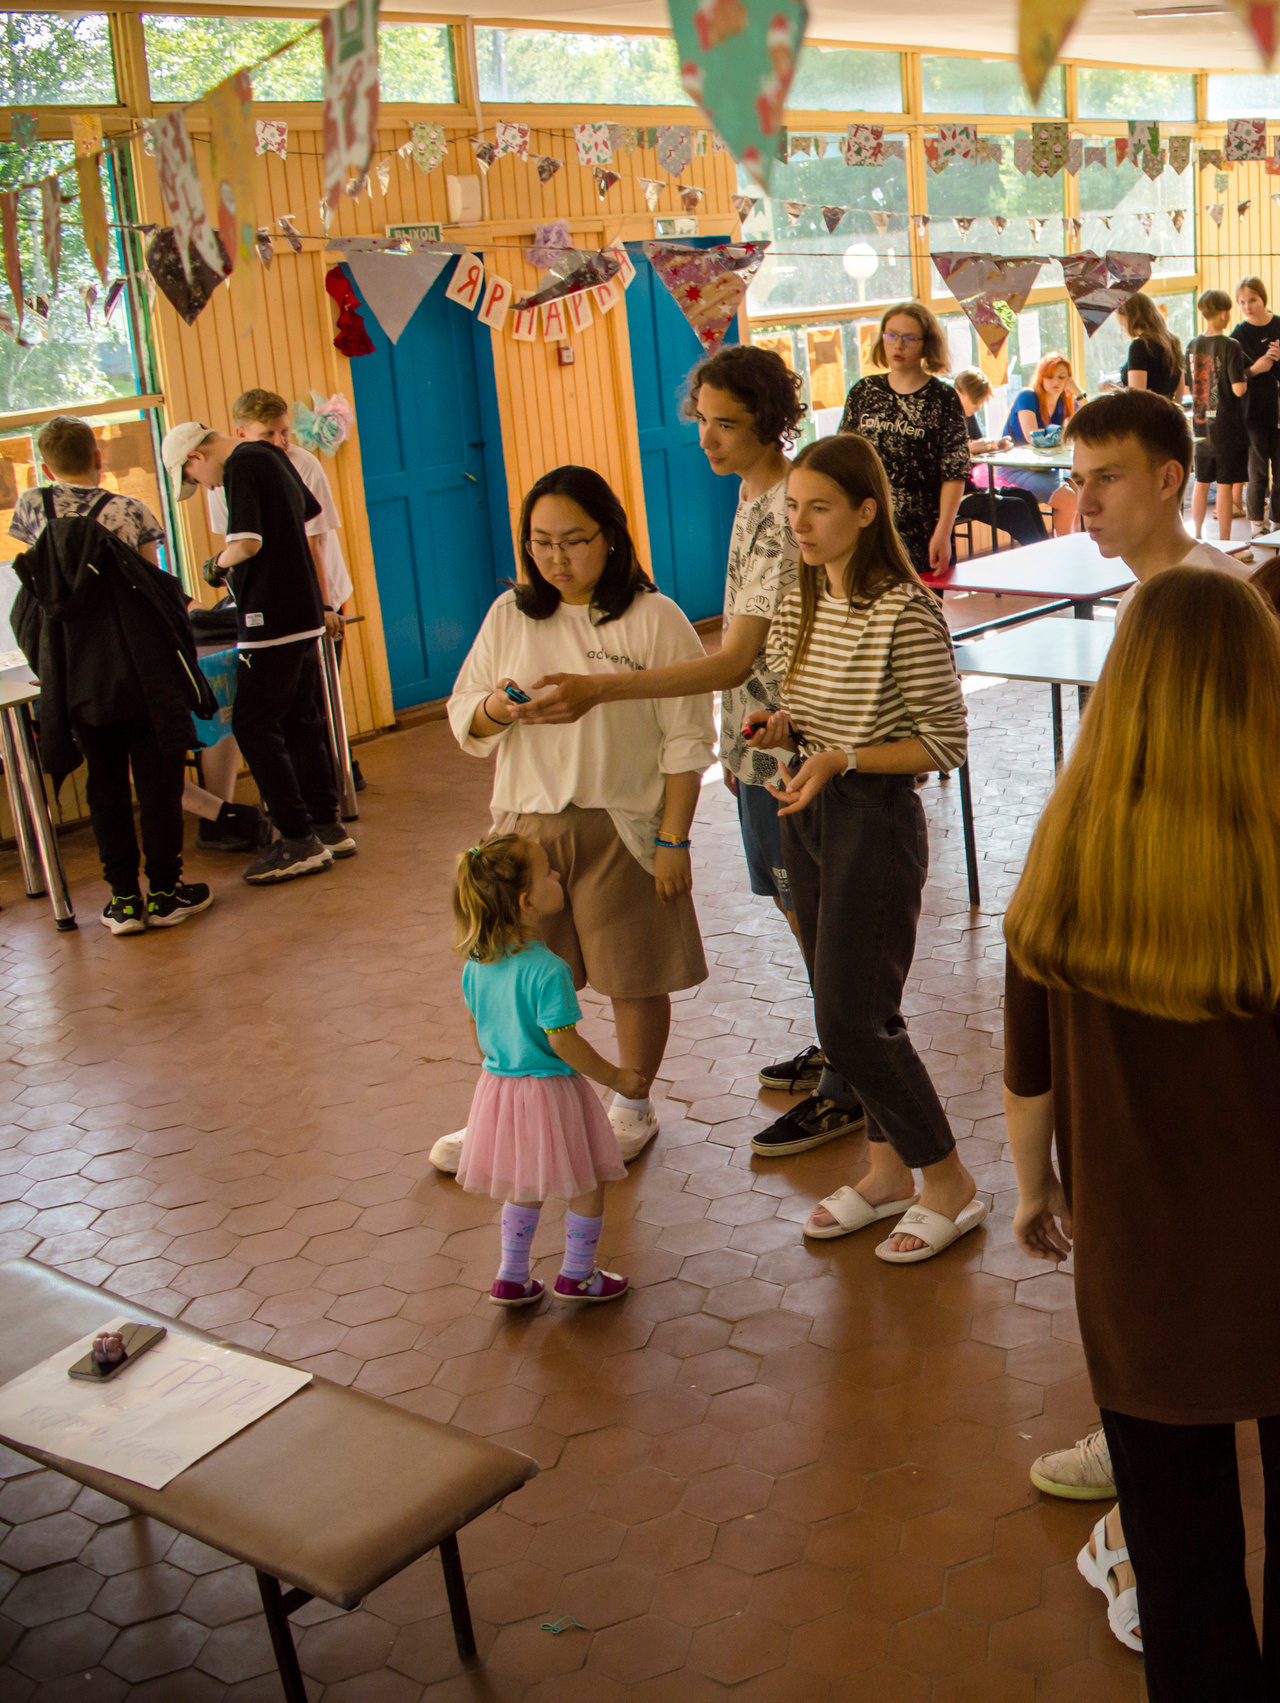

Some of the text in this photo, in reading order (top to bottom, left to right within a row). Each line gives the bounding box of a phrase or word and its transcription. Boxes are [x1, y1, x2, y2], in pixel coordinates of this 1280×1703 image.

[394, 227, 438, 241] ВЫХОД
[860, 413, 926, 440] Calvin Klein
